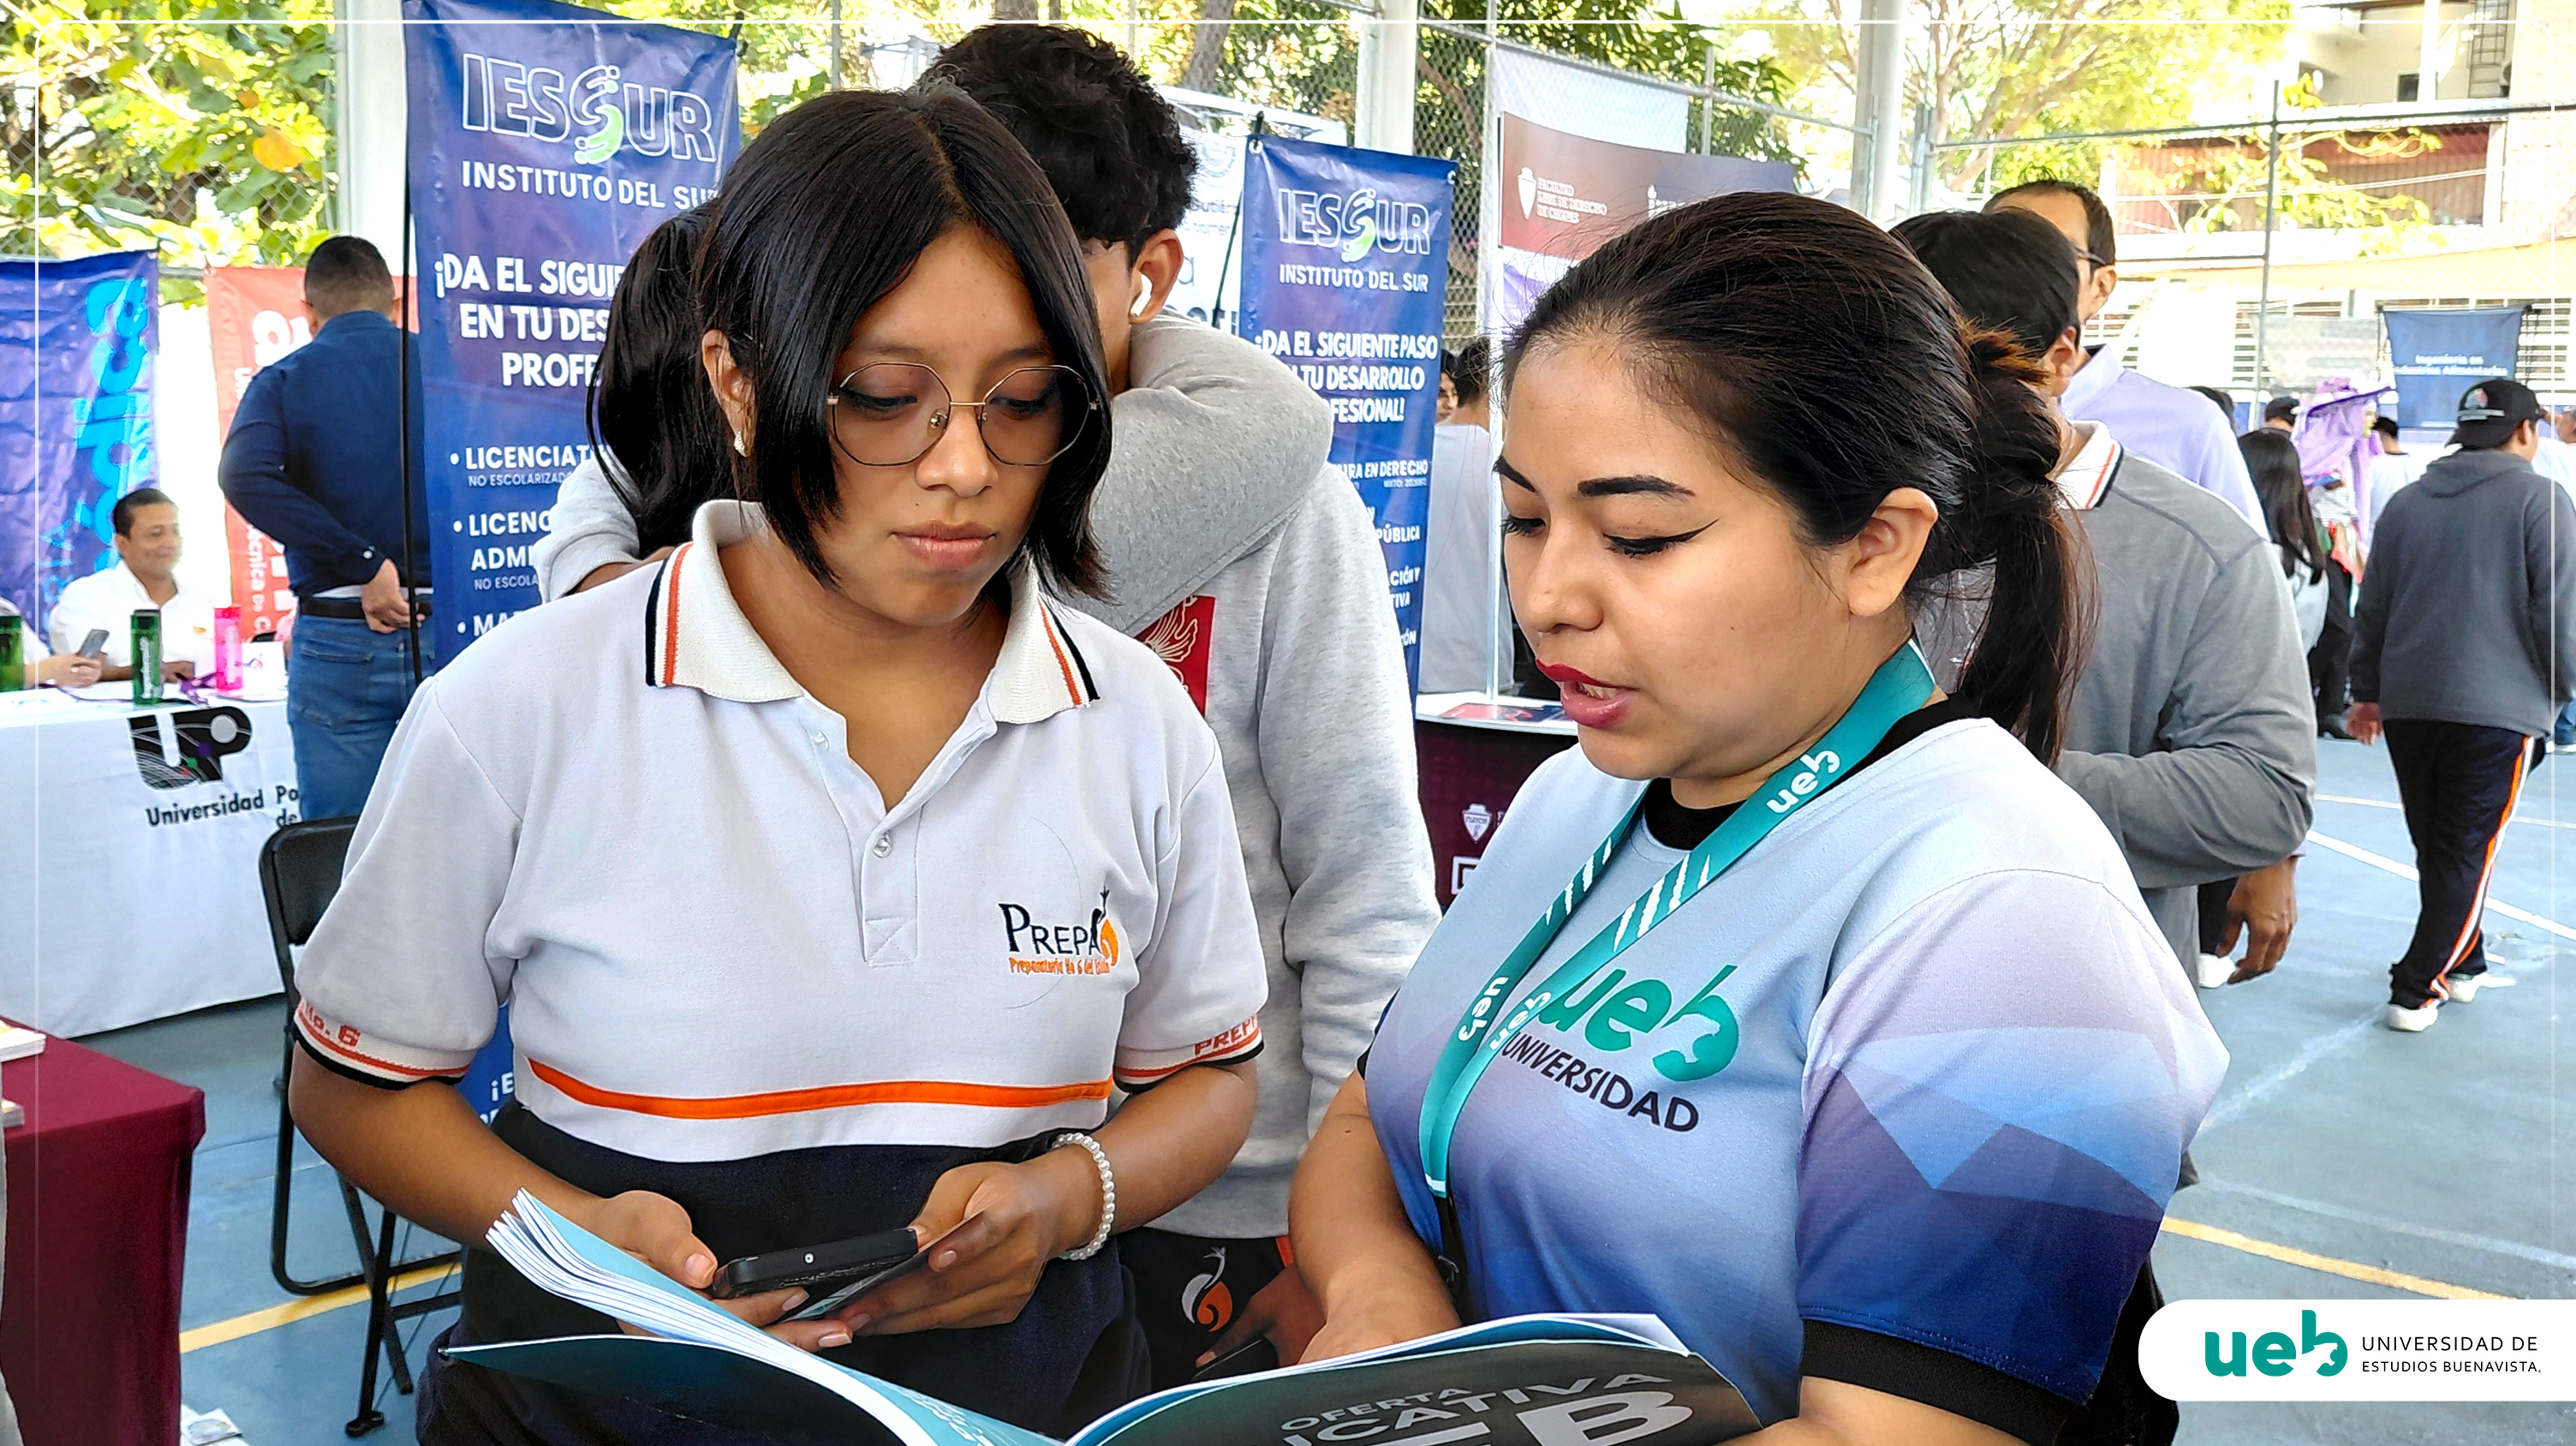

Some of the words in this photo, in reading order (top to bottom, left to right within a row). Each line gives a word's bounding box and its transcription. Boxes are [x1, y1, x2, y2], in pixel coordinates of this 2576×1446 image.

[462, 160, 611, 202] INSTITUTO
[618, 179, 665, 208] DEL
[434, 254, 490, 299] ¡DA
[496, 257, 533, 293] EL
[1279, 264, 1364, 290] INSTITUTO
[1370, 269, 1399, 291] DEL
[1403, 271, 1428, 292] SUR
[459, 302, 504, 339] EN
[510, 305, 552, 341] TU
[1294, 331, 1314, 356] EL
[1316, 332, 1400, 359] SIGUIENTE
[1399, 334, 1439, 360] PASO
[1300, 365, 1324, 391] TU
[1327, 365, 1426, 391] DESARROLLO
[1328, 397, 1405, 423] FESIONAL!
[468, 475, 487, 487] NO
[1364, 461, 1379, 479] EN
[1380, 459, 1428, 477] DERECHO
[1375, 523, 1421, 544] PÚBLICA
[474, 577, 492, 591] NO
[1389, 565, 1414, 586] CIÓN
[128, 706, 252, 790] UP
[146, 789, 265, 828] Universidad
[338, 1025, 361, 1047] 6
[1501, 1031, 1699, 1132] UNIVERSIDAD
[1280, 1388, 1473, 1431] OFERTA
